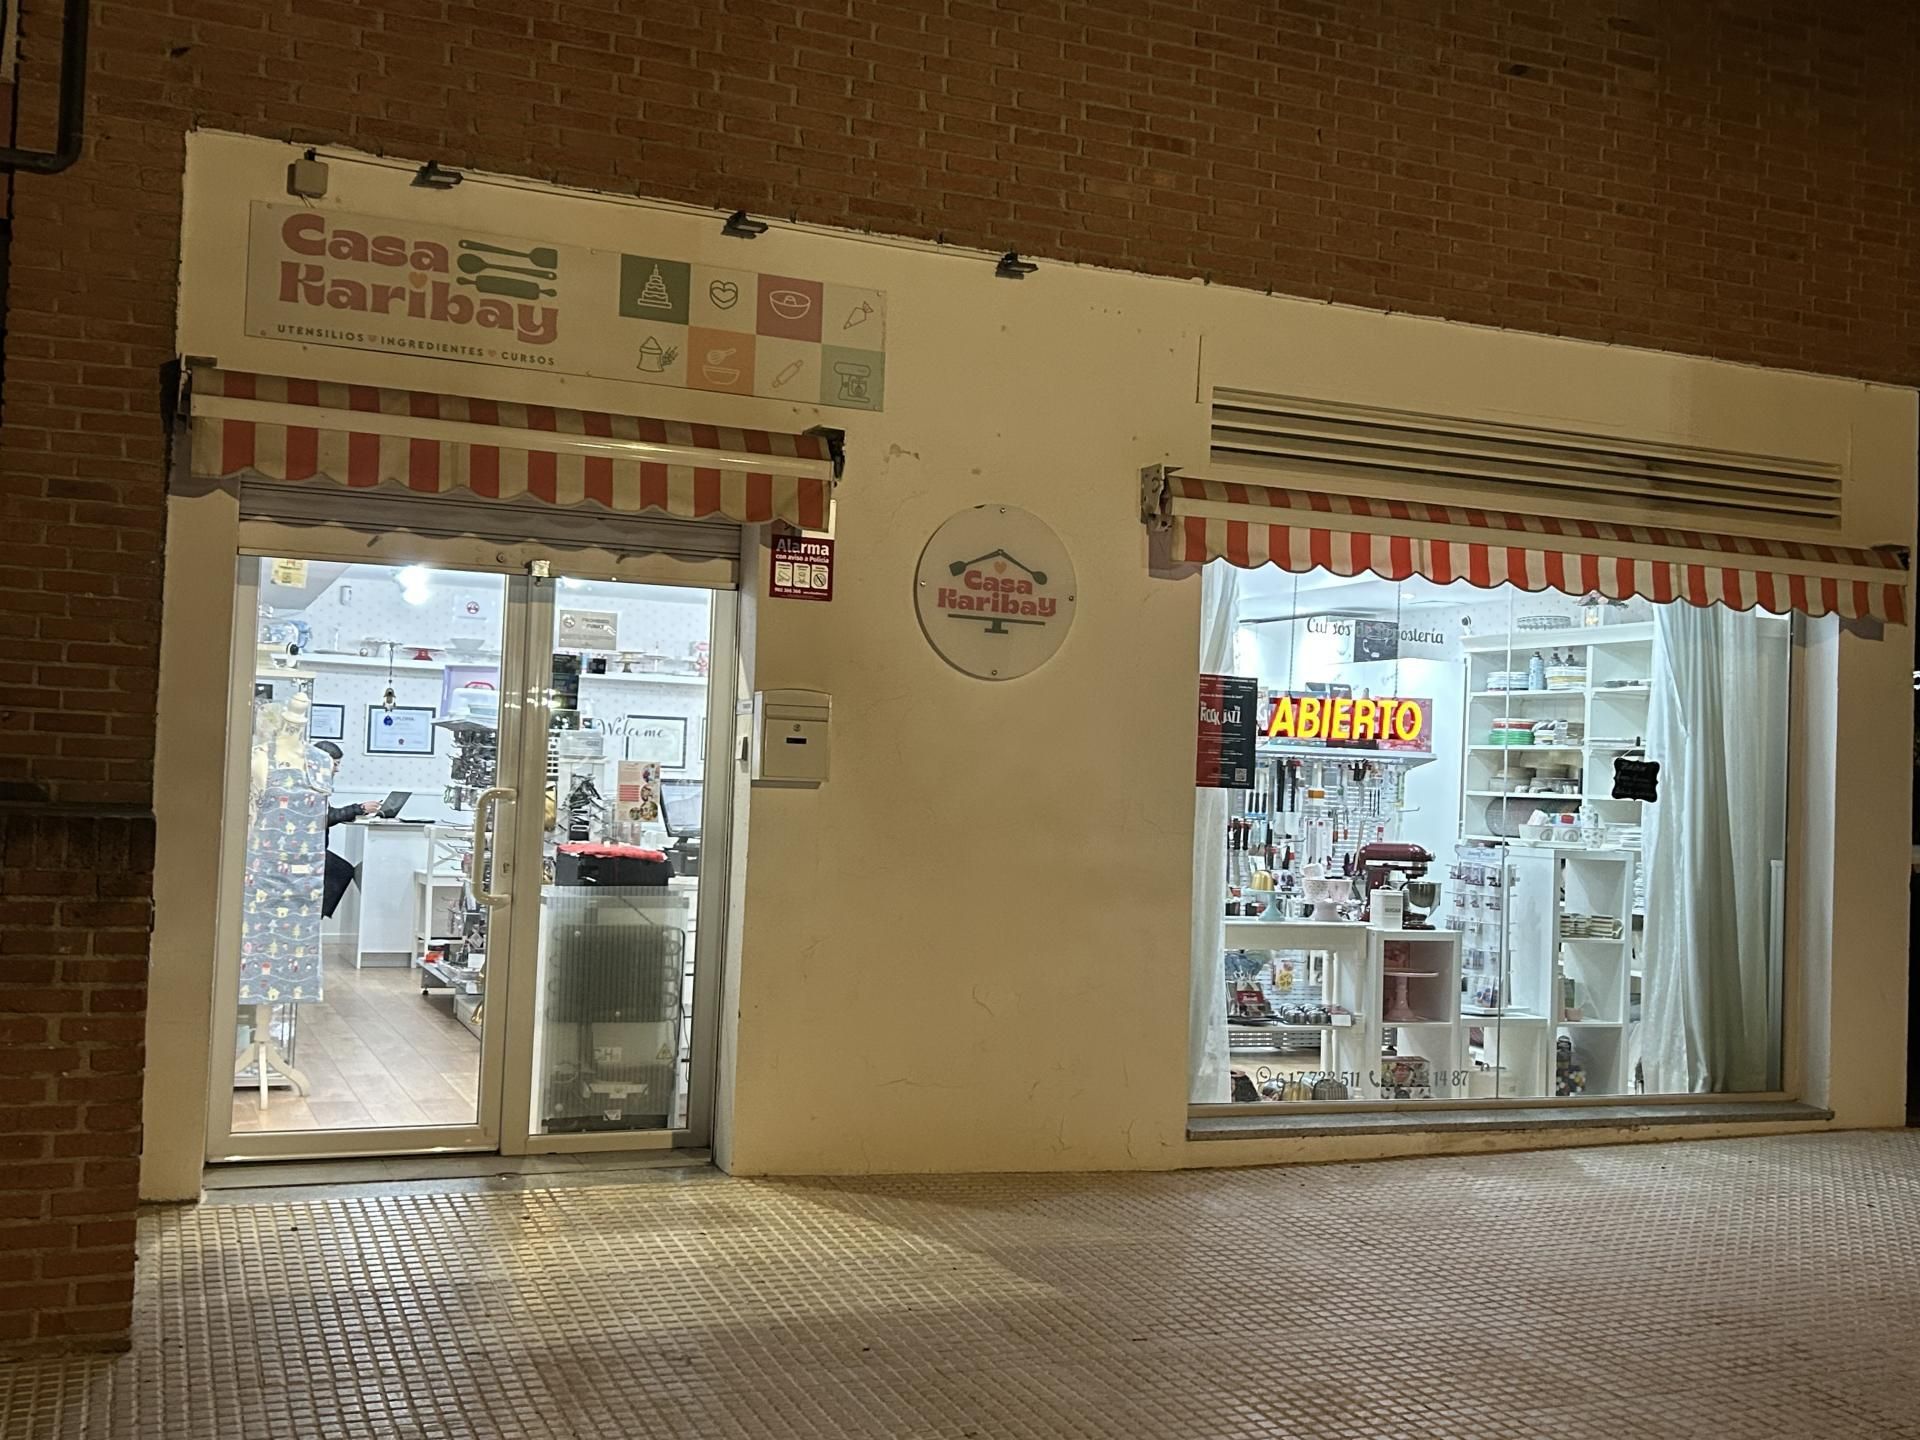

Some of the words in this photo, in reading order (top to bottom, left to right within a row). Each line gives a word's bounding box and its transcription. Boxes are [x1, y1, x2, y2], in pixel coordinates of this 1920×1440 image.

[281, 213, 449, 274] Casa
[279, 261, 559, 345] Karibay
[277, 324, 364, 342] UTENSILIOS
[380, 335, 484, 357] INGREDIENTES
[501, 351, 555, 366] CURSOS
[776, 538, 830, 556] Alarma
[963, 570, 1033, 595] Casa
[937, 588, 1057, 617] Karibay
[597, 714, 666, 738] Welcome
[1269, 696, 1423, 741] ABIERTO
[1276, 1071, 1304, 1088] 617
[1341, 1071, 1360, 1087] 511
[1433, 1070, 1448, 1087] 14
[1452, 1070, 1469, 1087] 87
